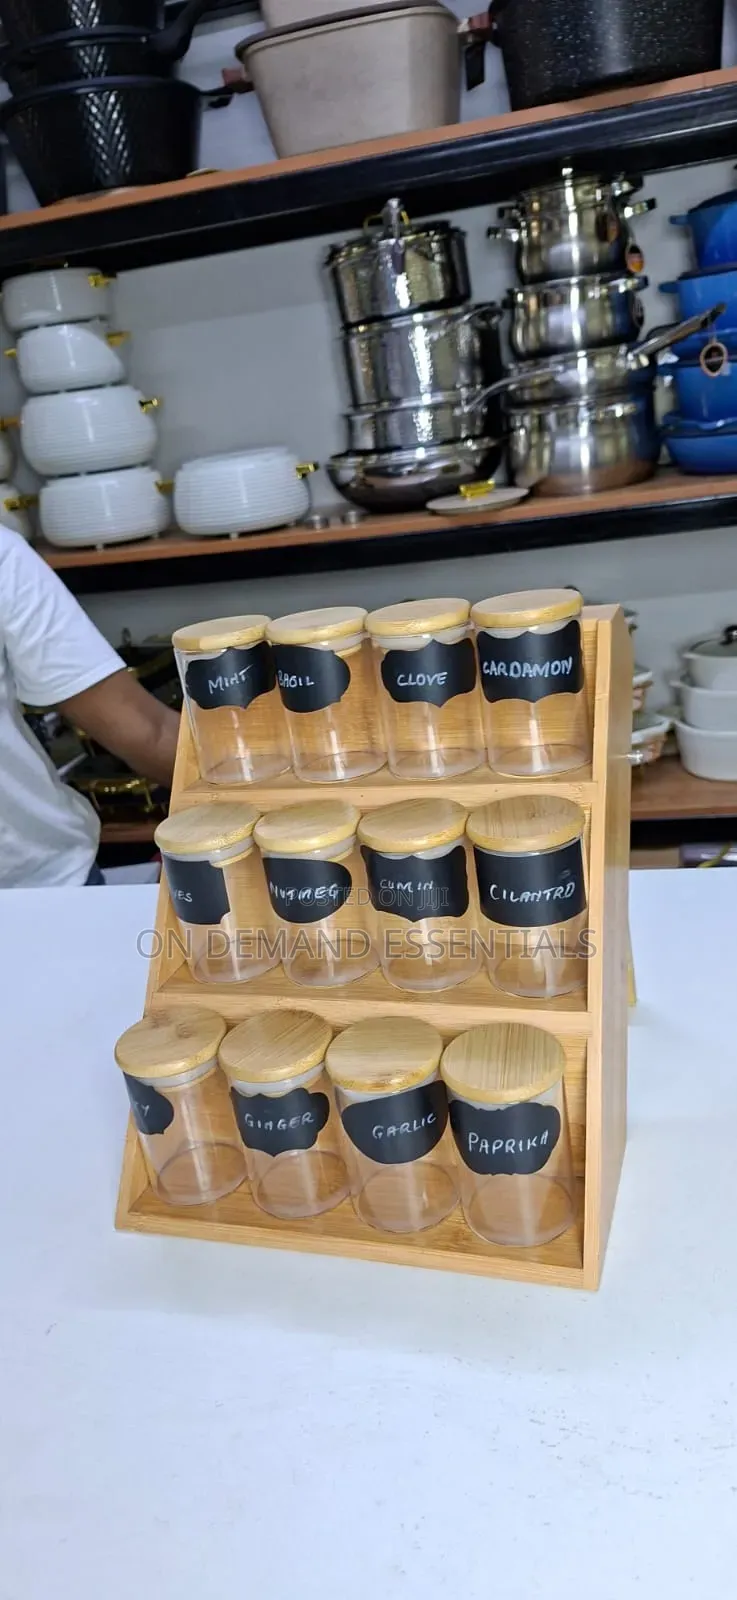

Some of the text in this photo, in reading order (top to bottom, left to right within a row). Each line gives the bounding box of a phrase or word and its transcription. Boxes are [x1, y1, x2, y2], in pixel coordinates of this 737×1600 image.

[208, 664, 252, 695] MINT
[396, 671, 448, 687] CLOVE
[379, 879, 434, 893] CUMIN
[243, 1111, 315, 1131] GINGER
[371, 1112, 438, 1140] GARLIC
[467, 1130, 550, 1154] PAPRIKA
